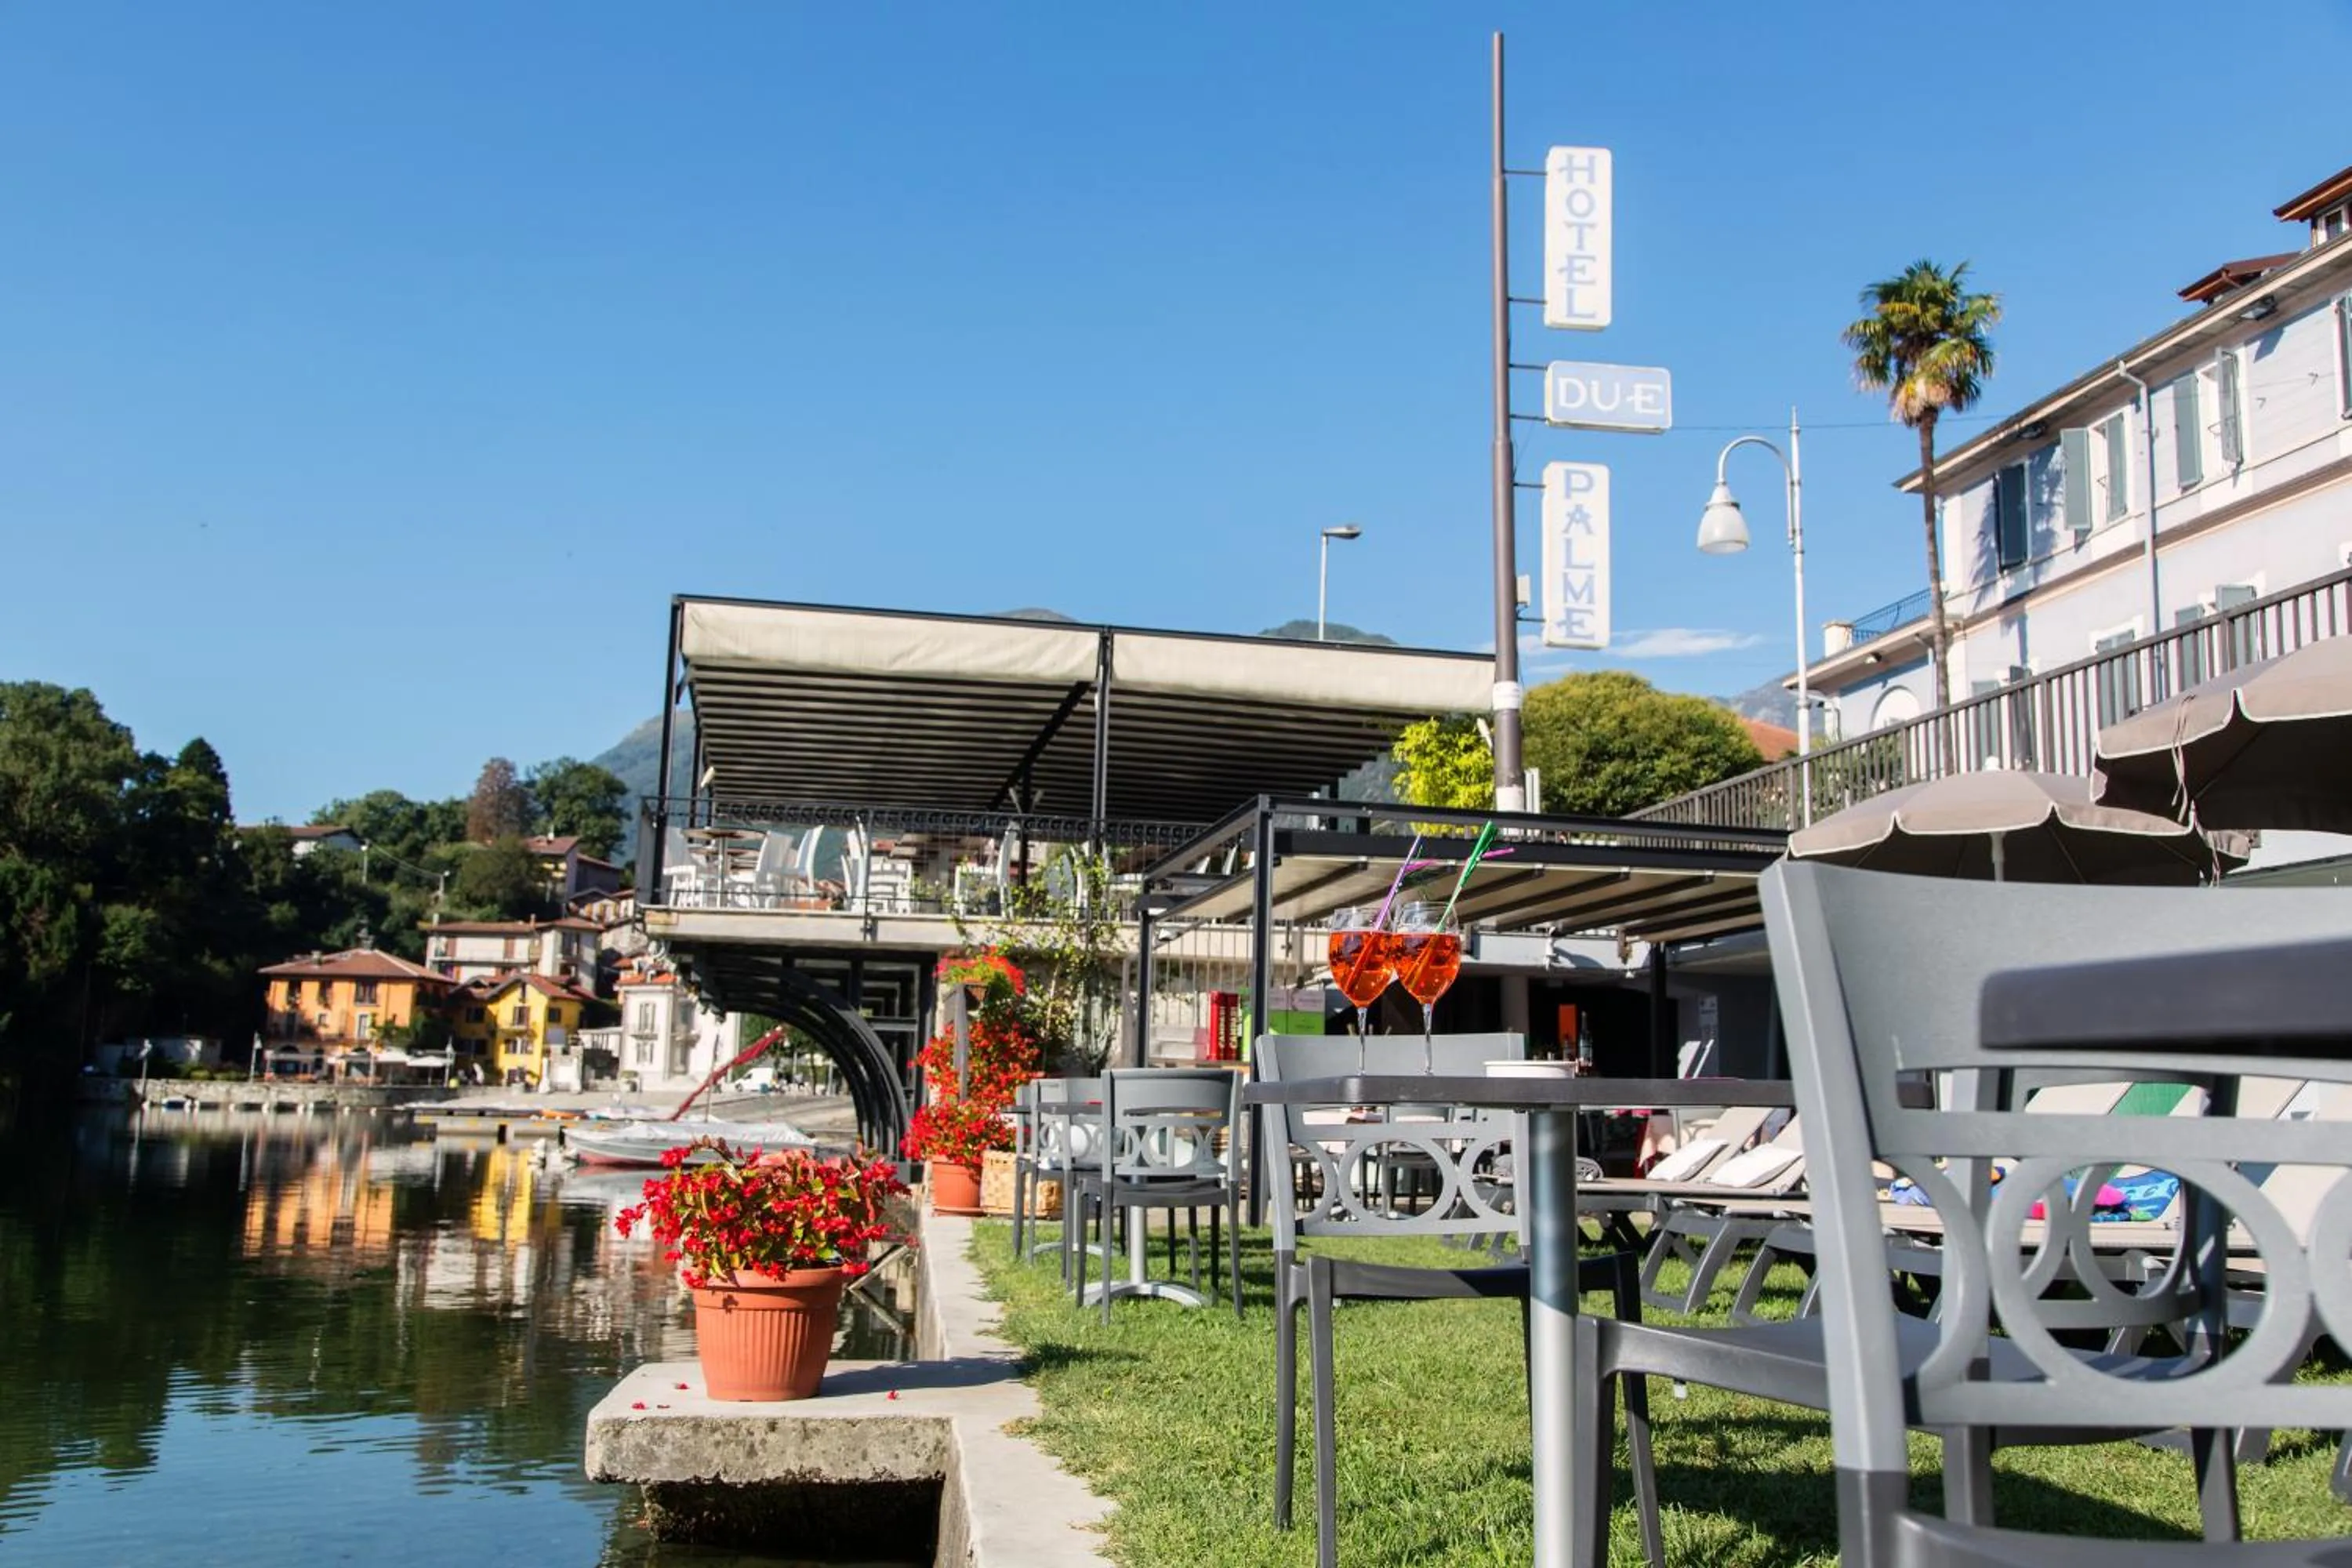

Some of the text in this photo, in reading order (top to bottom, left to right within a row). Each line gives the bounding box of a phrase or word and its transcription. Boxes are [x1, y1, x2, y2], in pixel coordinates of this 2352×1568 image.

[1557, 154, 1596, 319] HOTEL
[1558, 377, 1664, 415] DUE
[1555, 469, 1595, 641] PALME
